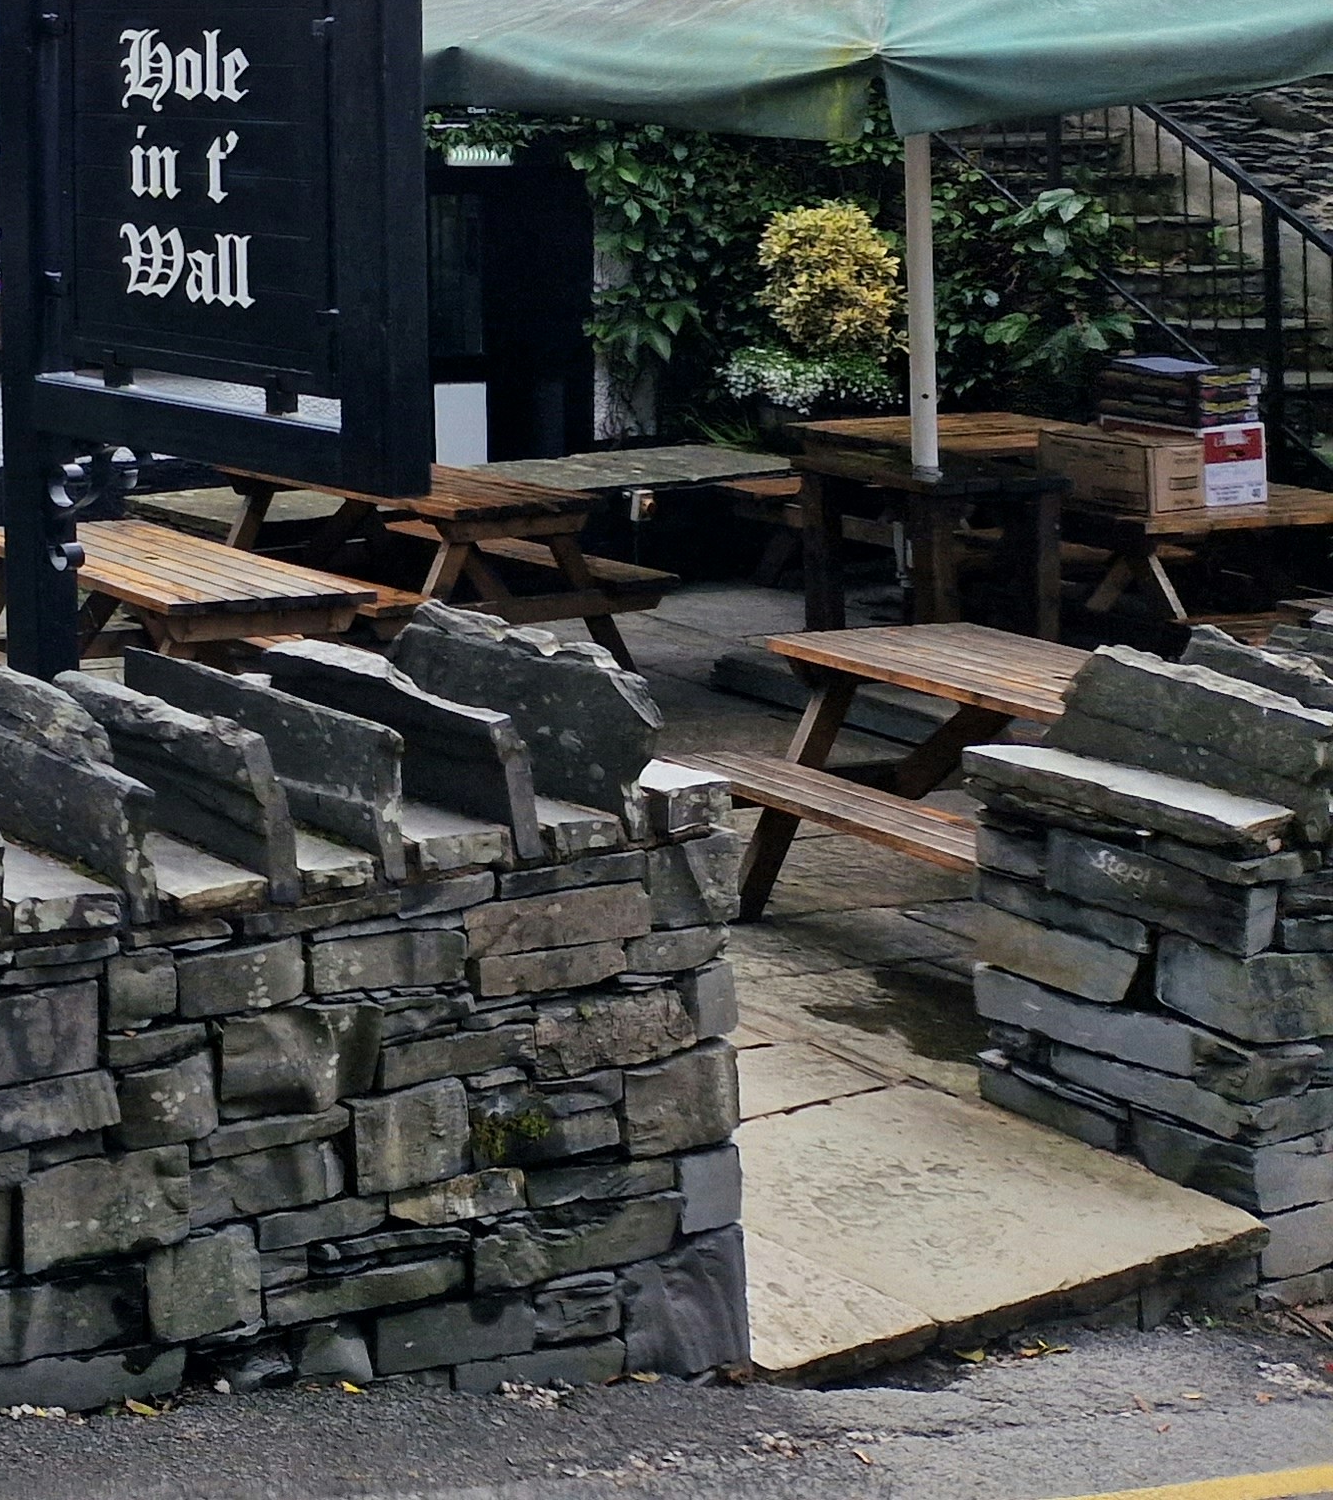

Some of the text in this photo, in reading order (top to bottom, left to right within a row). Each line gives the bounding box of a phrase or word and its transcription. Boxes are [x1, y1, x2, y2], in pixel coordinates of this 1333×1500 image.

[119, 28, 250, 112] Hole
[130, 125, 239, 203] in t'
[119, 222, 256, 309] Wall
